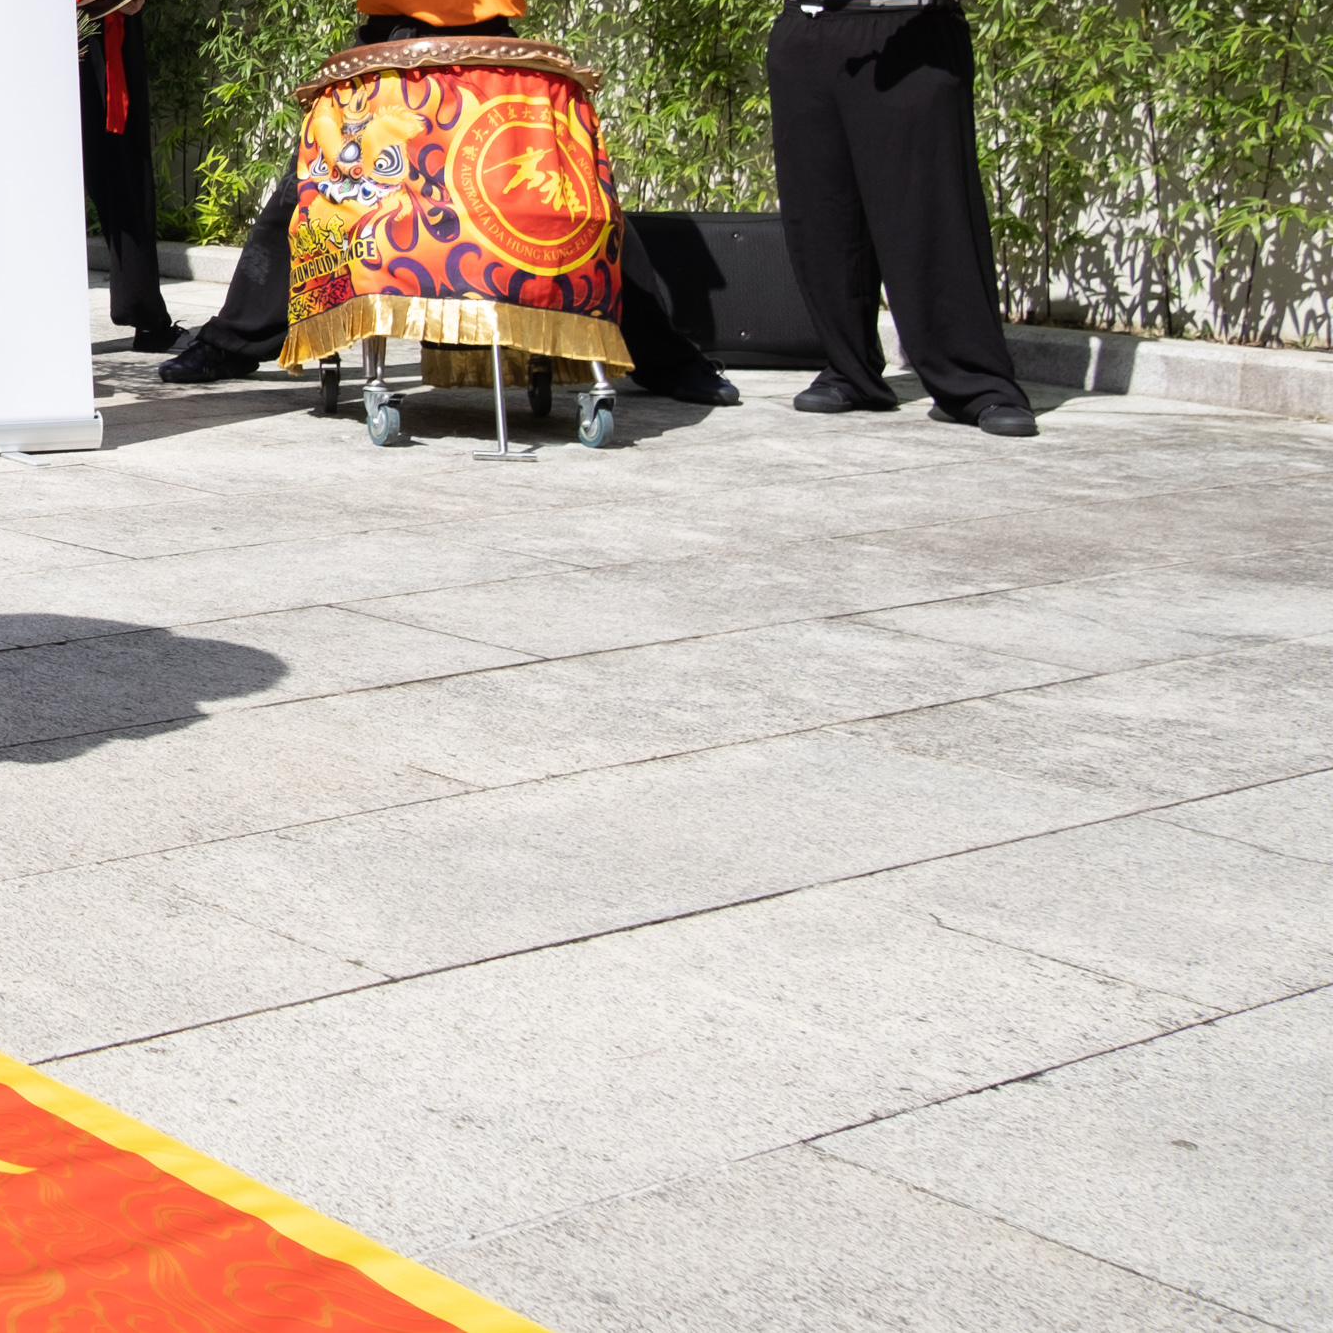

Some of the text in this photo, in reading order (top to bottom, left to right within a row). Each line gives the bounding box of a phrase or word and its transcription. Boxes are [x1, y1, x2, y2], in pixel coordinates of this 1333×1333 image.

[461, 164, 491, 226] AUSTRALIA
[488, 223, 505, 243] DA
[506, 237, 541, 260] HUNG
[315, 251, 339, 275] LION
